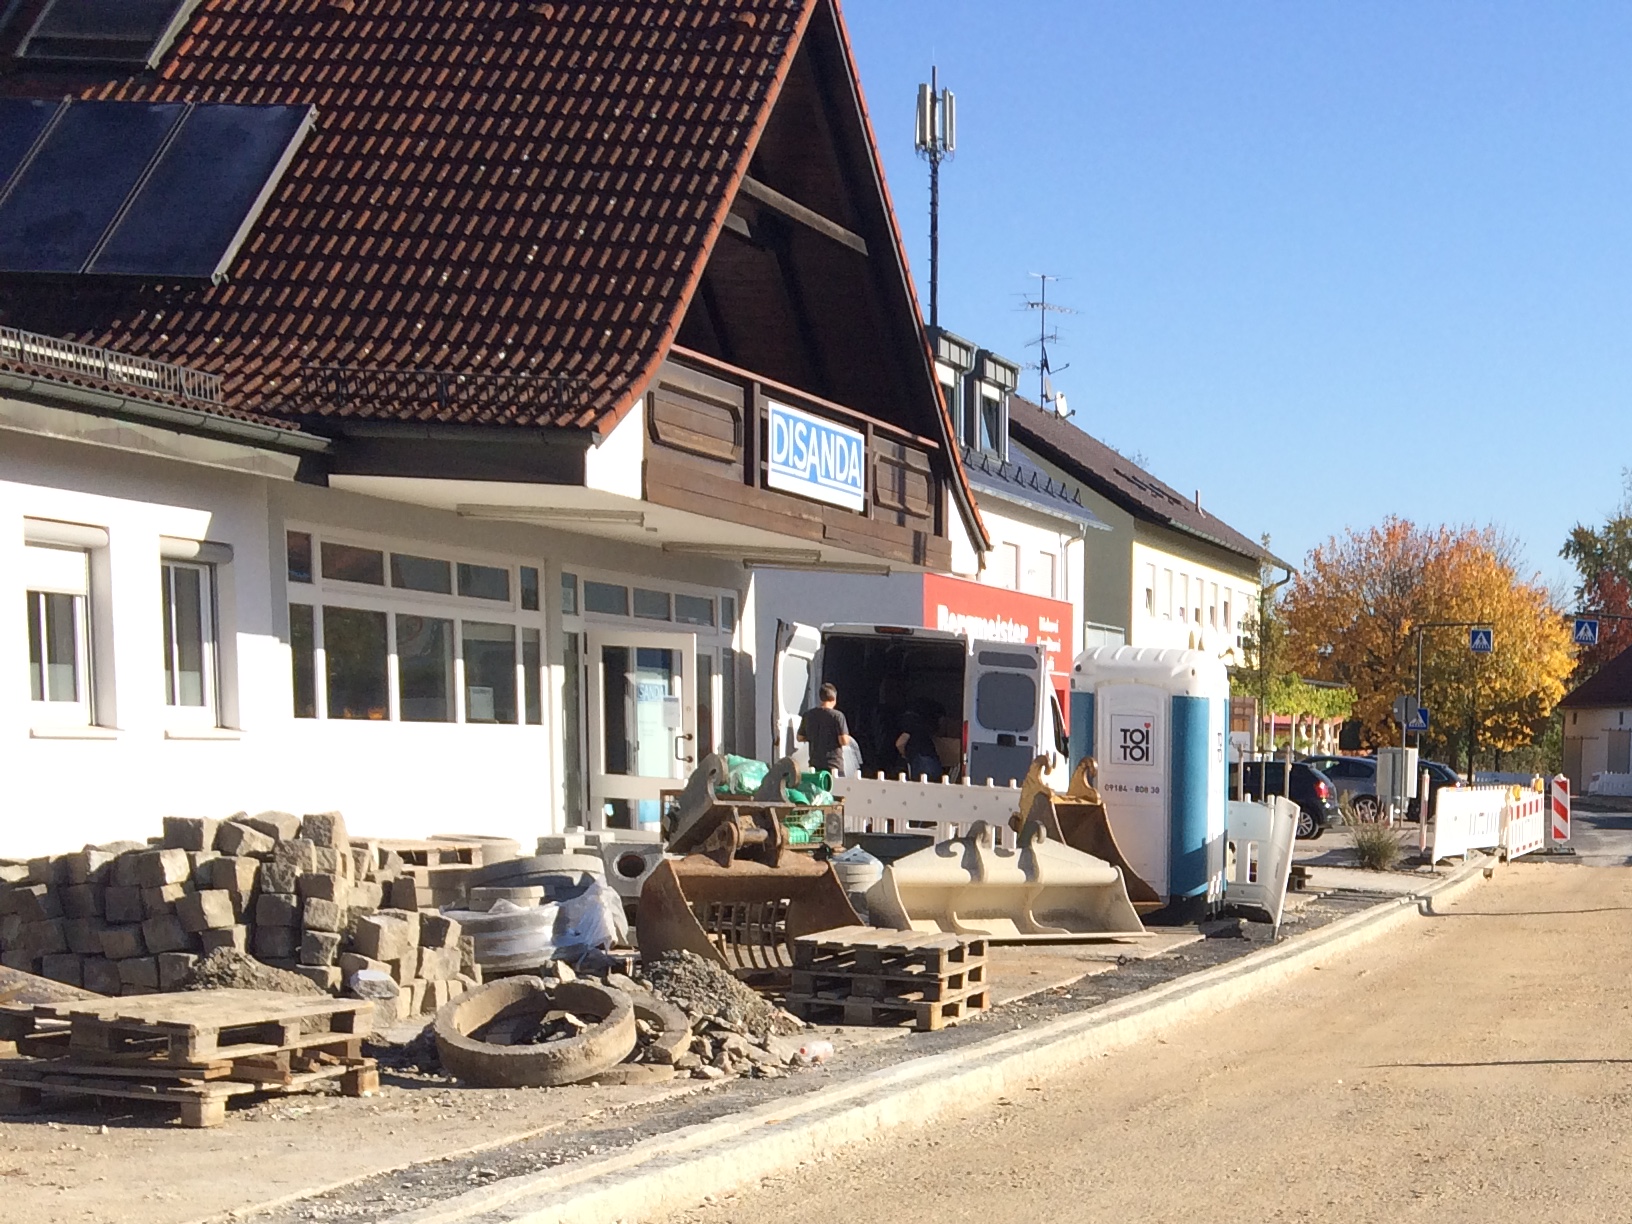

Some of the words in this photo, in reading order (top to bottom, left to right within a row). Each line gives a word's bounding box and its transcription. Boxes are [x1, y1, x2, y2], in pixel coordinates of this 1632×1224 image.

[773, 413, 861, 487] DISANDA
[1120, 724, 1149, 745] TOI
[1120, 745, 1149, 762] TOI
